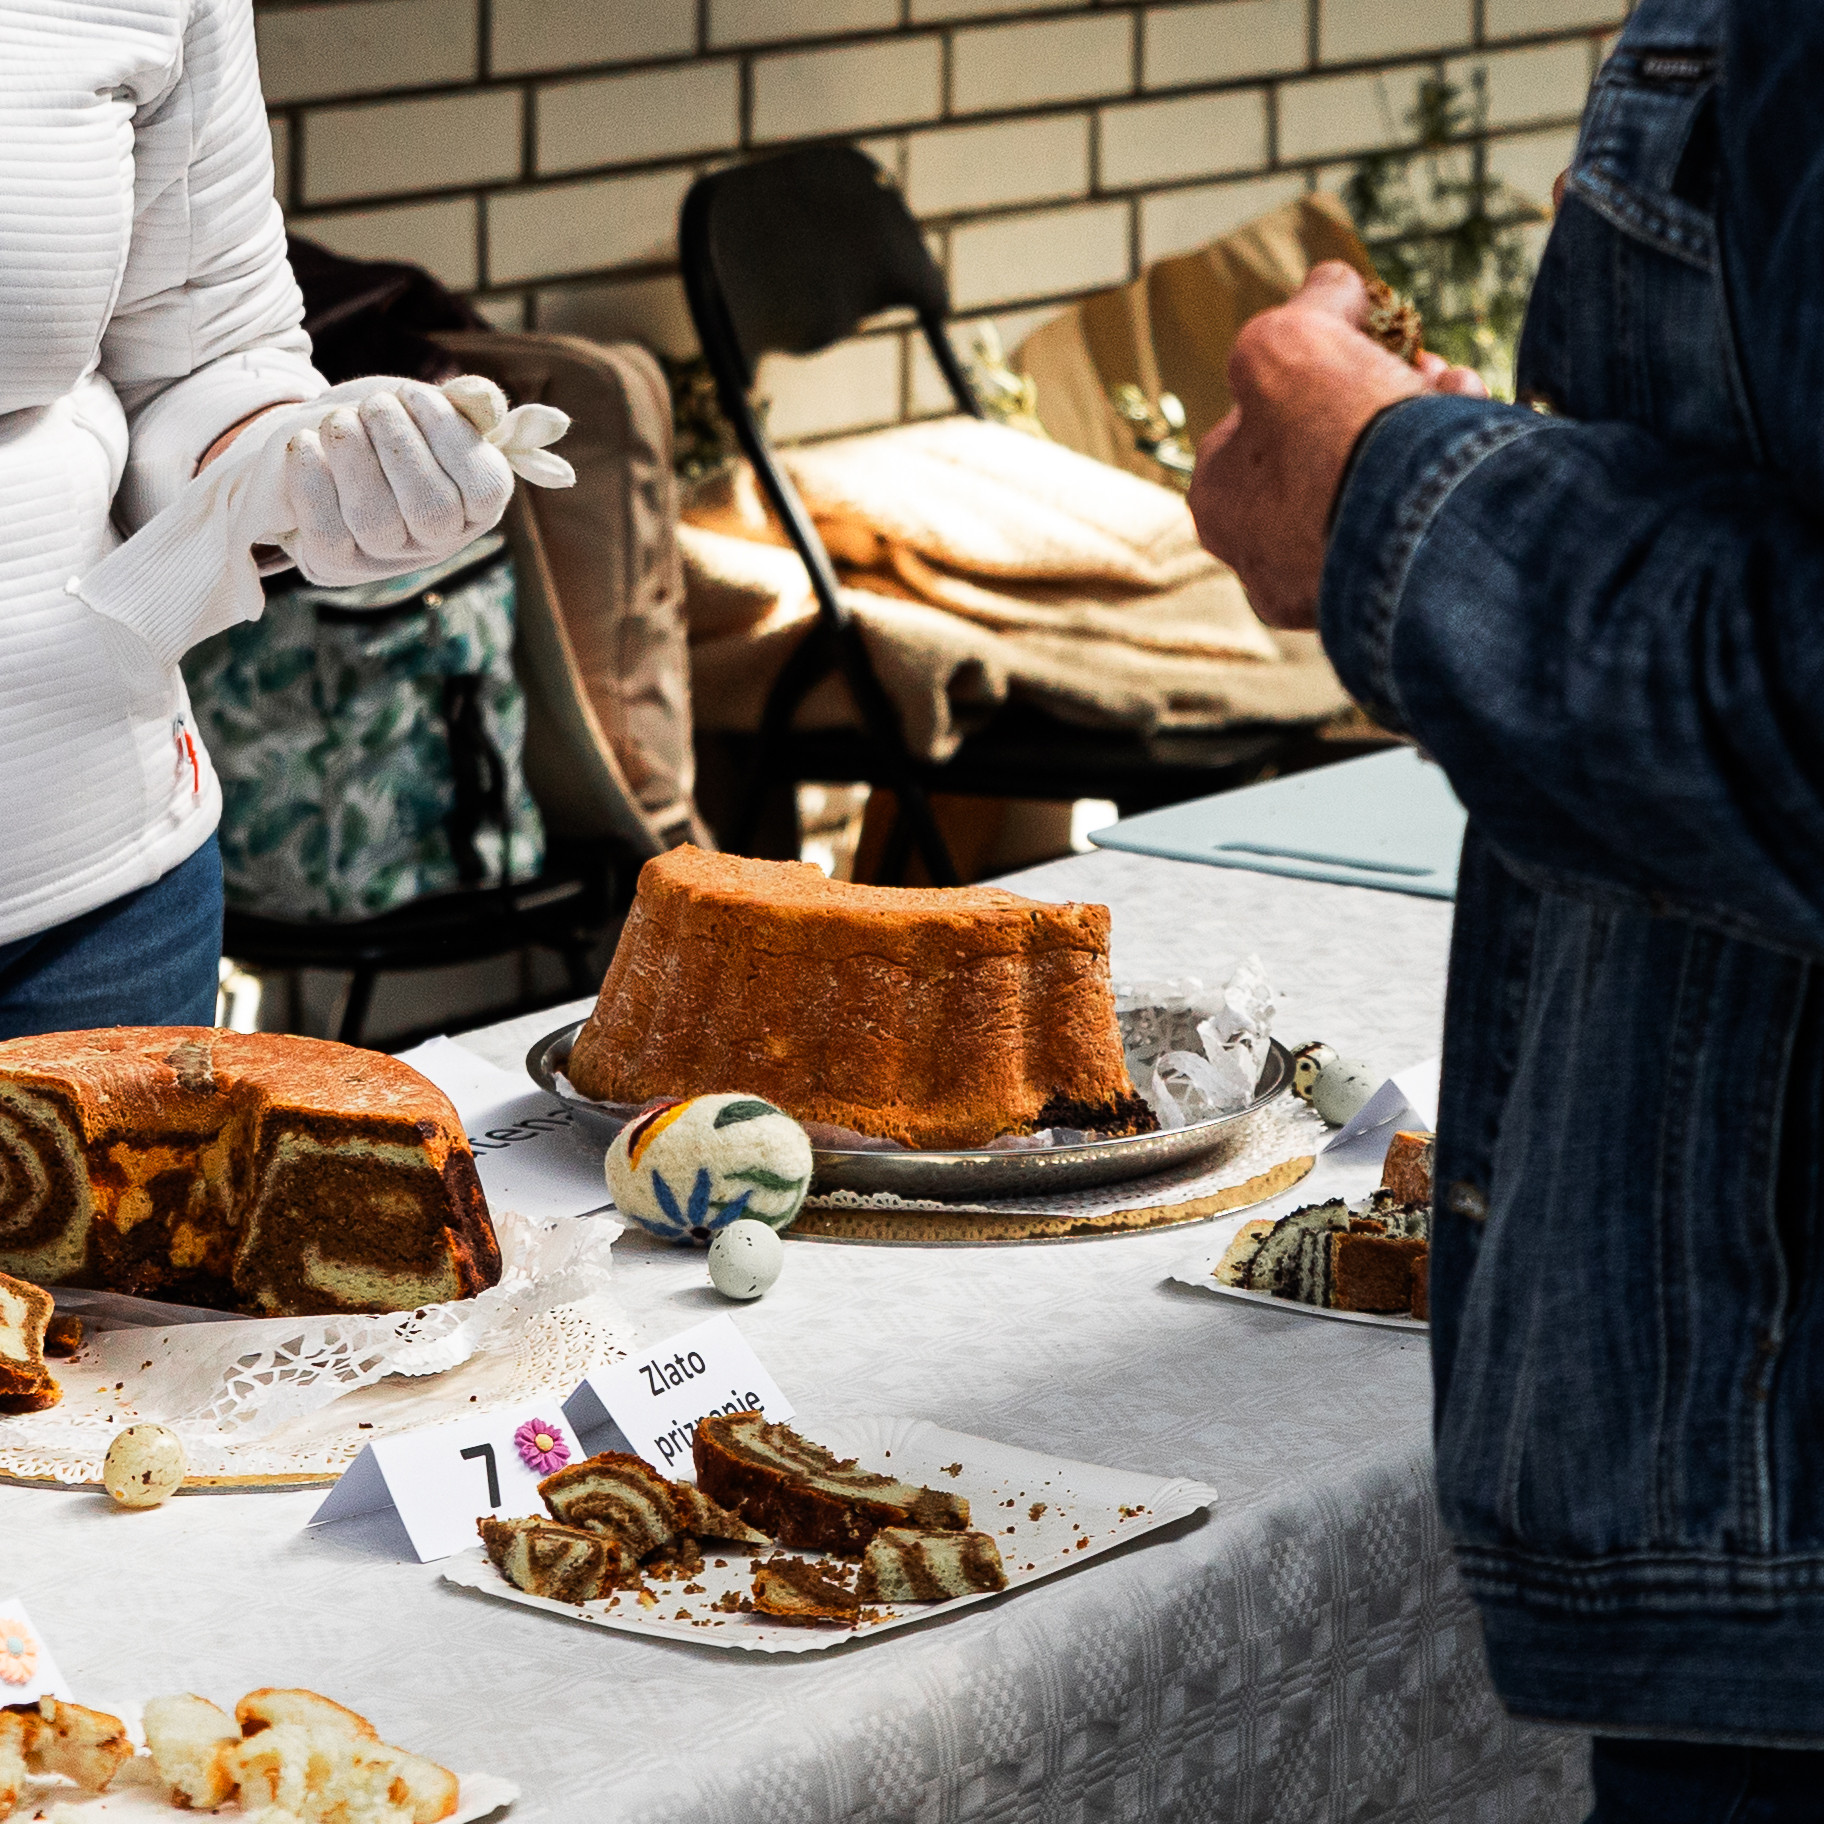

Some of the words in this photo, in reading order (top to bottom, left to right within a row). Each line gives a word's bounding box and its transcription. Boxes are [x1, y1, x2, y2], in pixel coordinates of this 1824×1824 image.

[638, 1351, 706, 1396] Zlato
[654, 1389, 765, 1467] prine
[460, 1442, 502, 1508] 7
